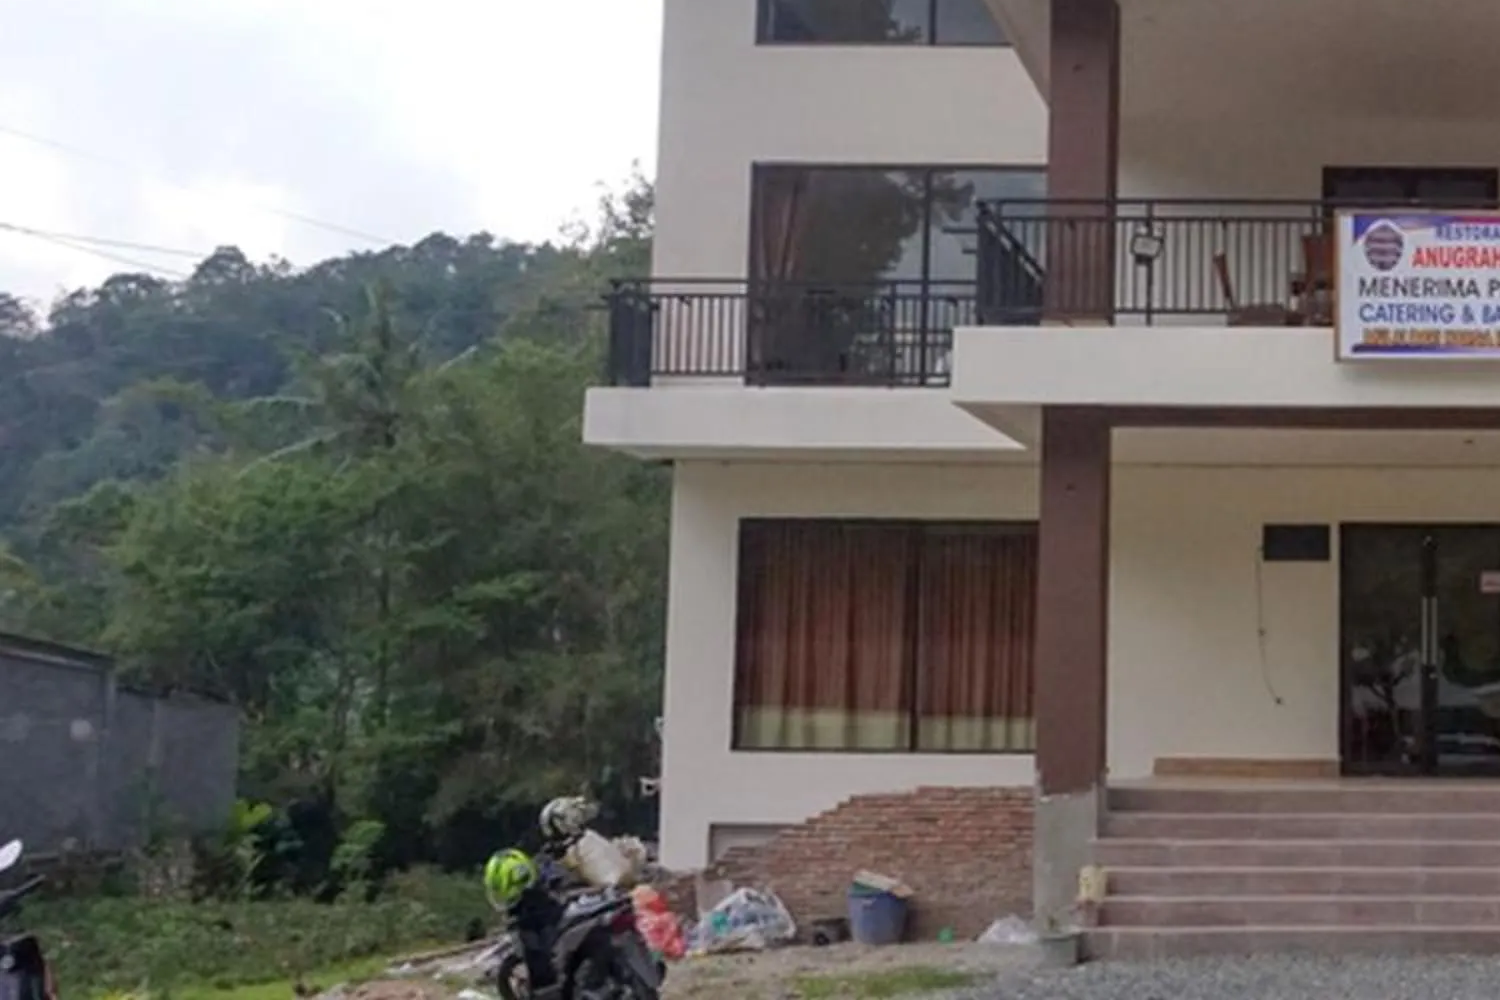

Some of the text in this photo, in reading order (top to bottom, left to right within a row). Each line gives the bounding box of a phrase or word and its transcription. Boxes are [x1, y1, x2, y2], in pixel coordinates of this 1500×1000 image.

[1358, 276, 1480, 297] MENERIMA
[1358, 303, 1454, 324] CATERING
[1463, 305, 1475, 324] &
